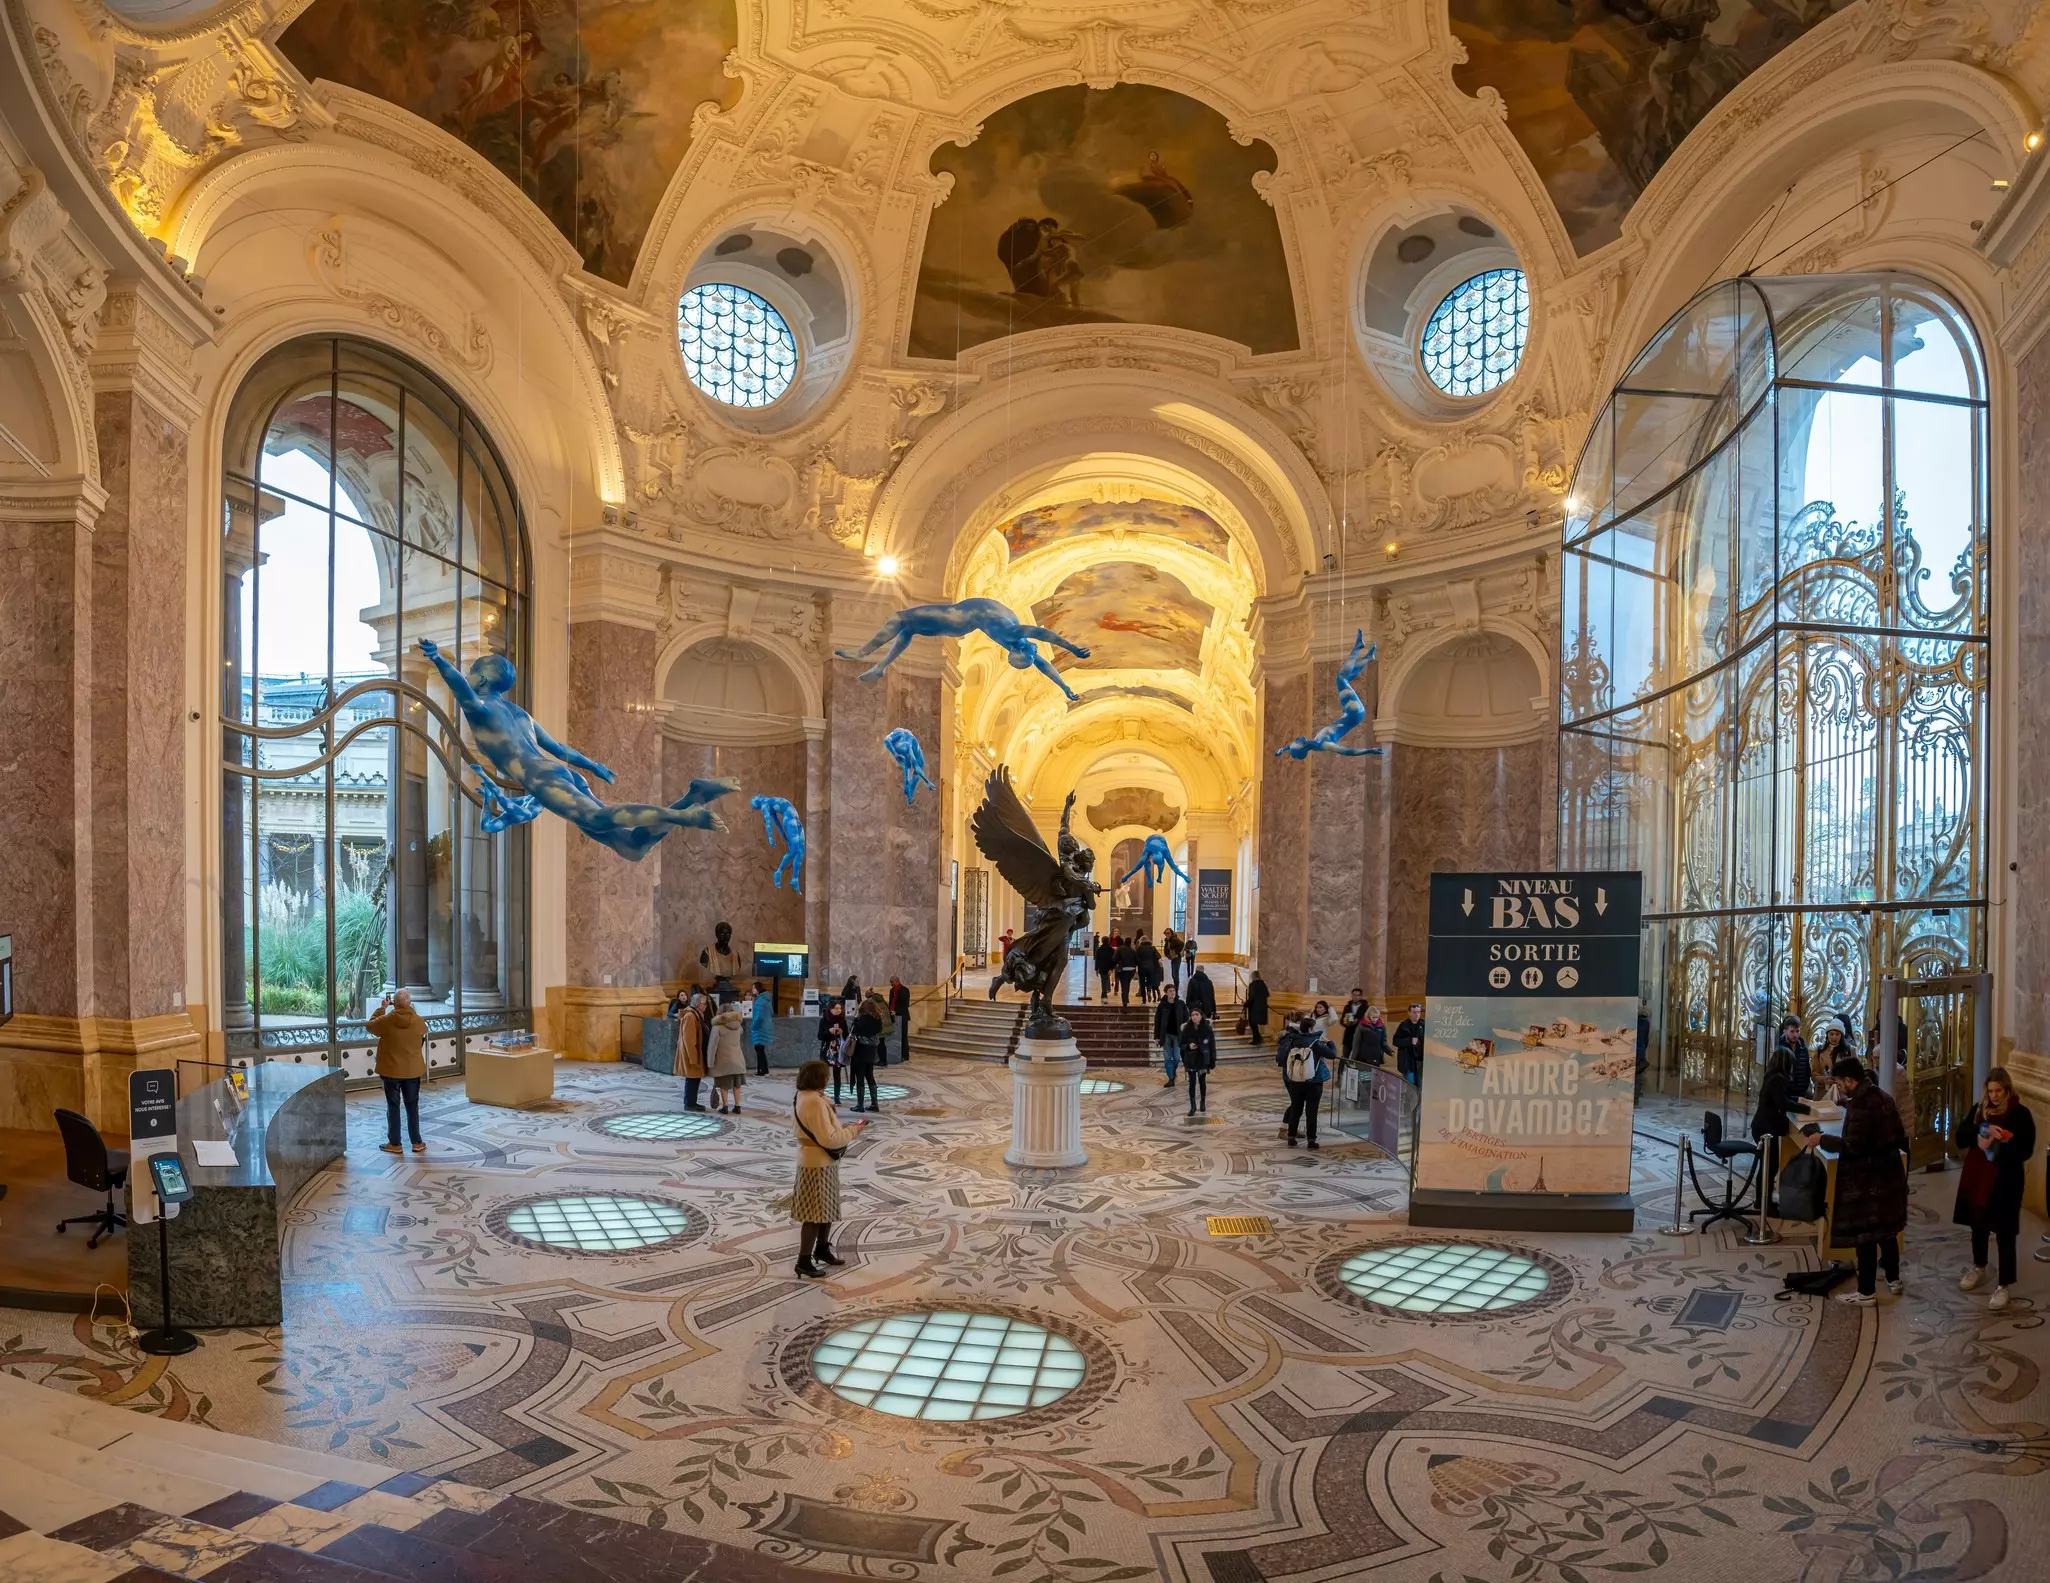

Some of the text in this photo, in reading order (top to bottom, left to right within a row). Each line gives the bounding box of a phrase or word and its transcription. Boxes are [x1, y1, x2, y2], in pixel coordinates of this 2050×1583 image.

[1498, 880, 1573, 894] NIVEAU
[1489, 896, 1580, 928] BAS
[1490, 944, 1580, 961] SORTIE
[1455, 1015, 1474, 1026] déc.
[1433, 1027, 1459, 1038] 2022
[1438, 1127, 1452, 1140] DE
[1461, 1125, 1506, 1147] VERTIGES
